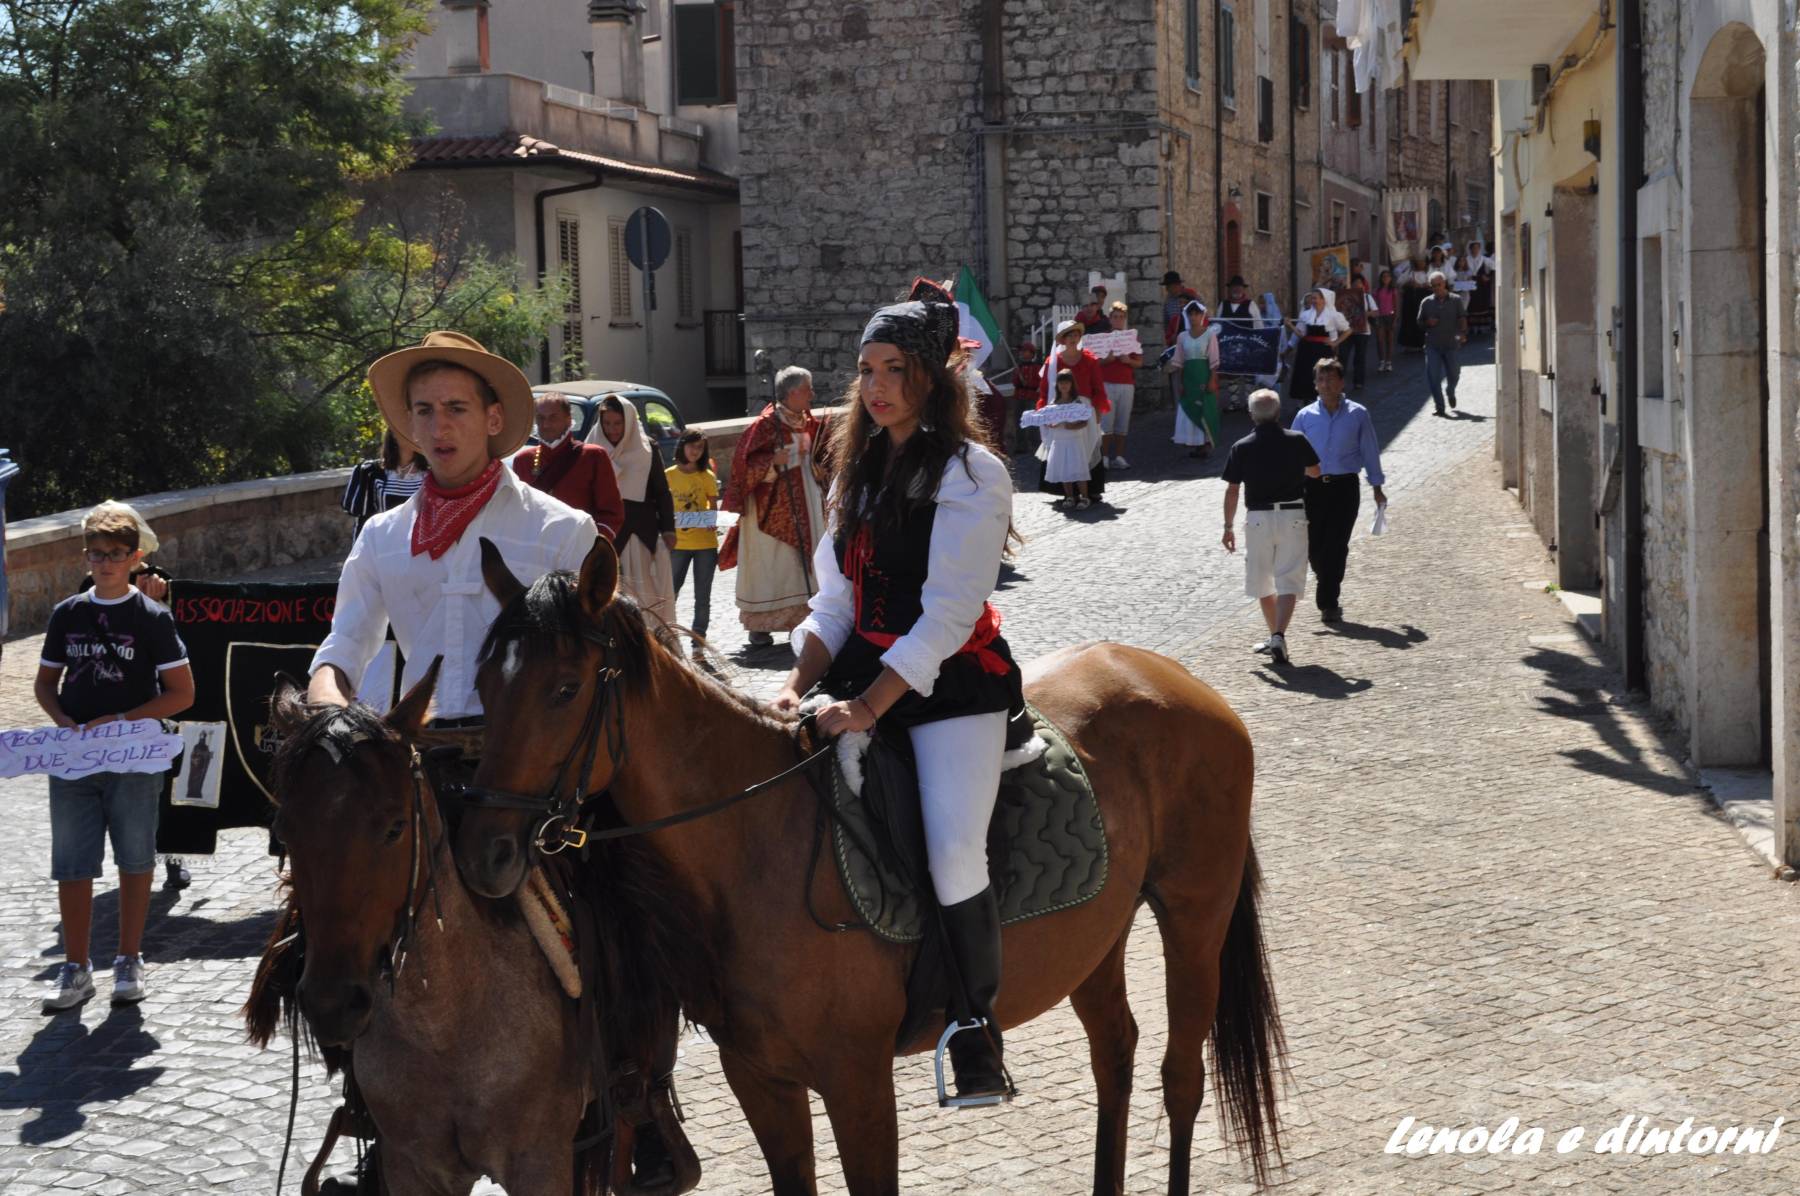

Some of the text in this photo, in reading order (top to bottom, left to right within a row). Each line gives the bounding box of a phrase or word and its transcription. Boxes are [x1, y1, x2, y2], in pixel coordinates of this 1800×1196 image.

[176, 597, 306, 623] ASSOCIAZIONE
[0, 728, 73, 753] REGNO
[23, 742, 168, 774] DUE SICILIE
